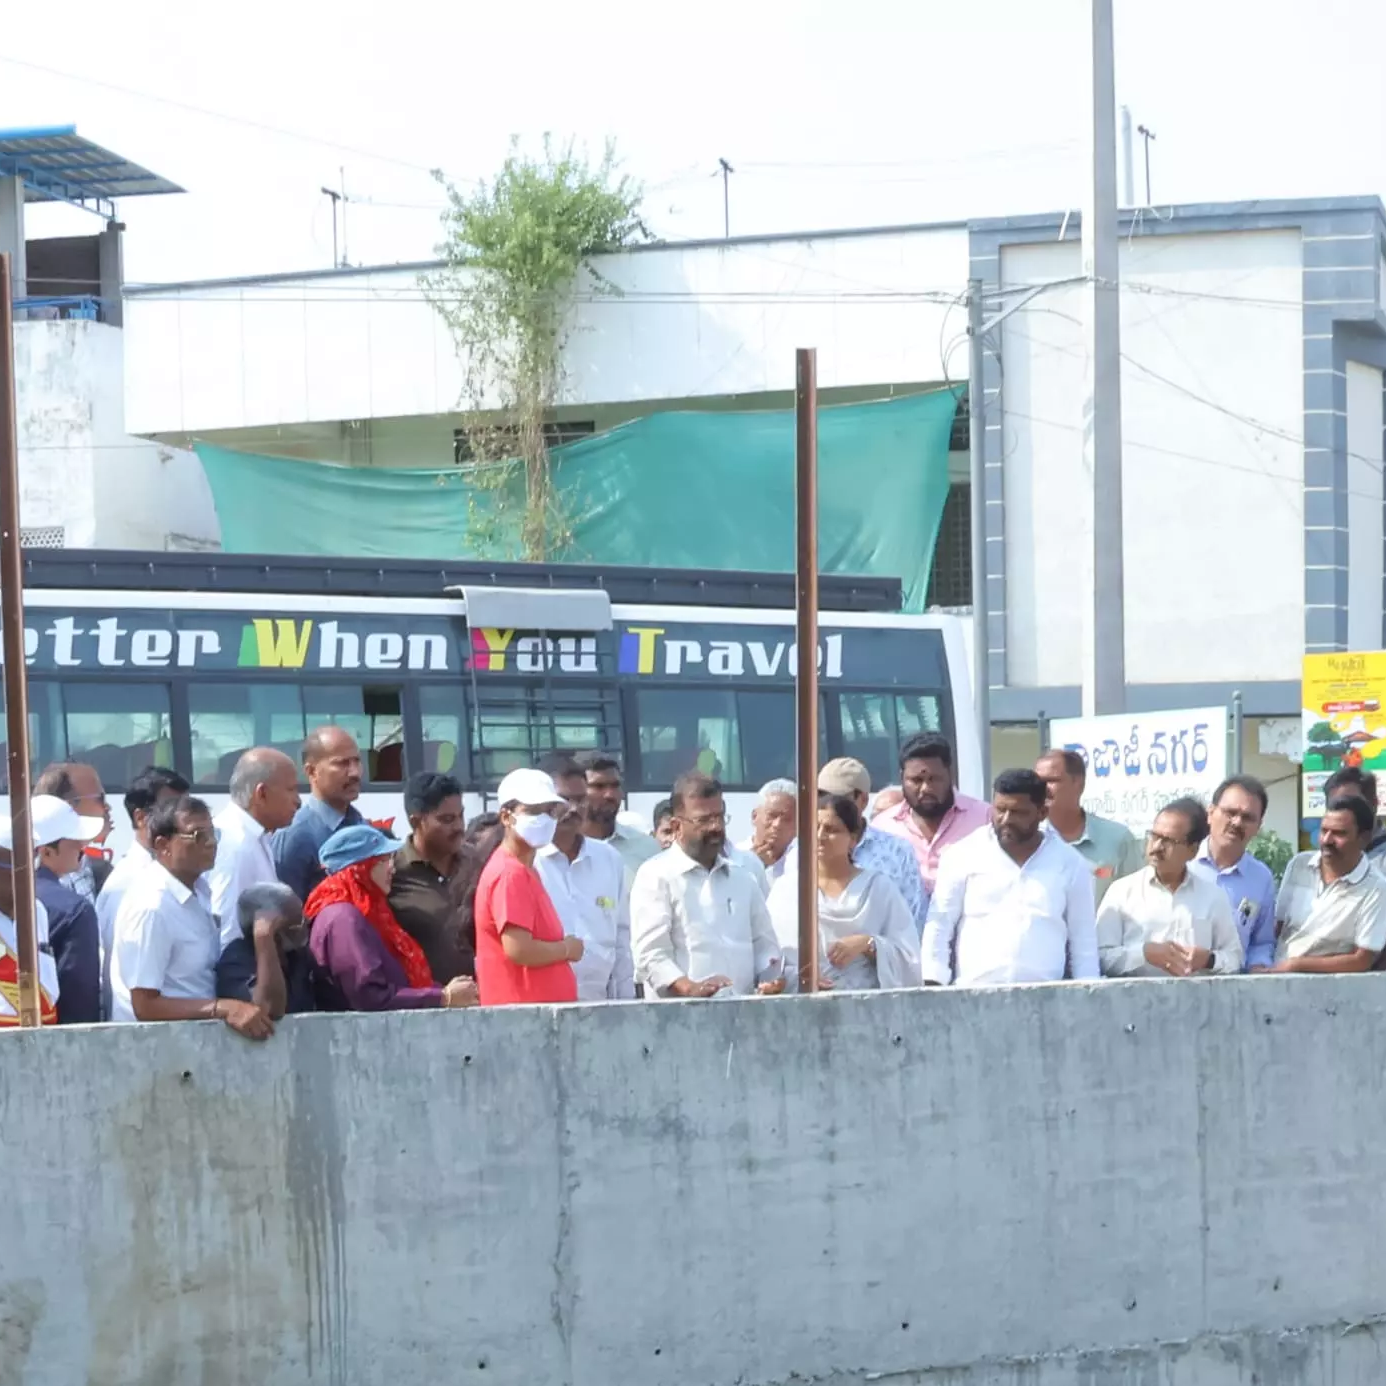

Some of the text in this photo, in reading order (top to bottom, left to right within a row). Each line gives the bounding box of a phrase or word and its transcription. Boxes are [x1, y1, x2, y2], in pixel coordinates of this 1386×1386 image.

[237, 618, 449, 670] When
[467, 627, 599, 673] You
[1147, 723, 1209, 776] నగర్
